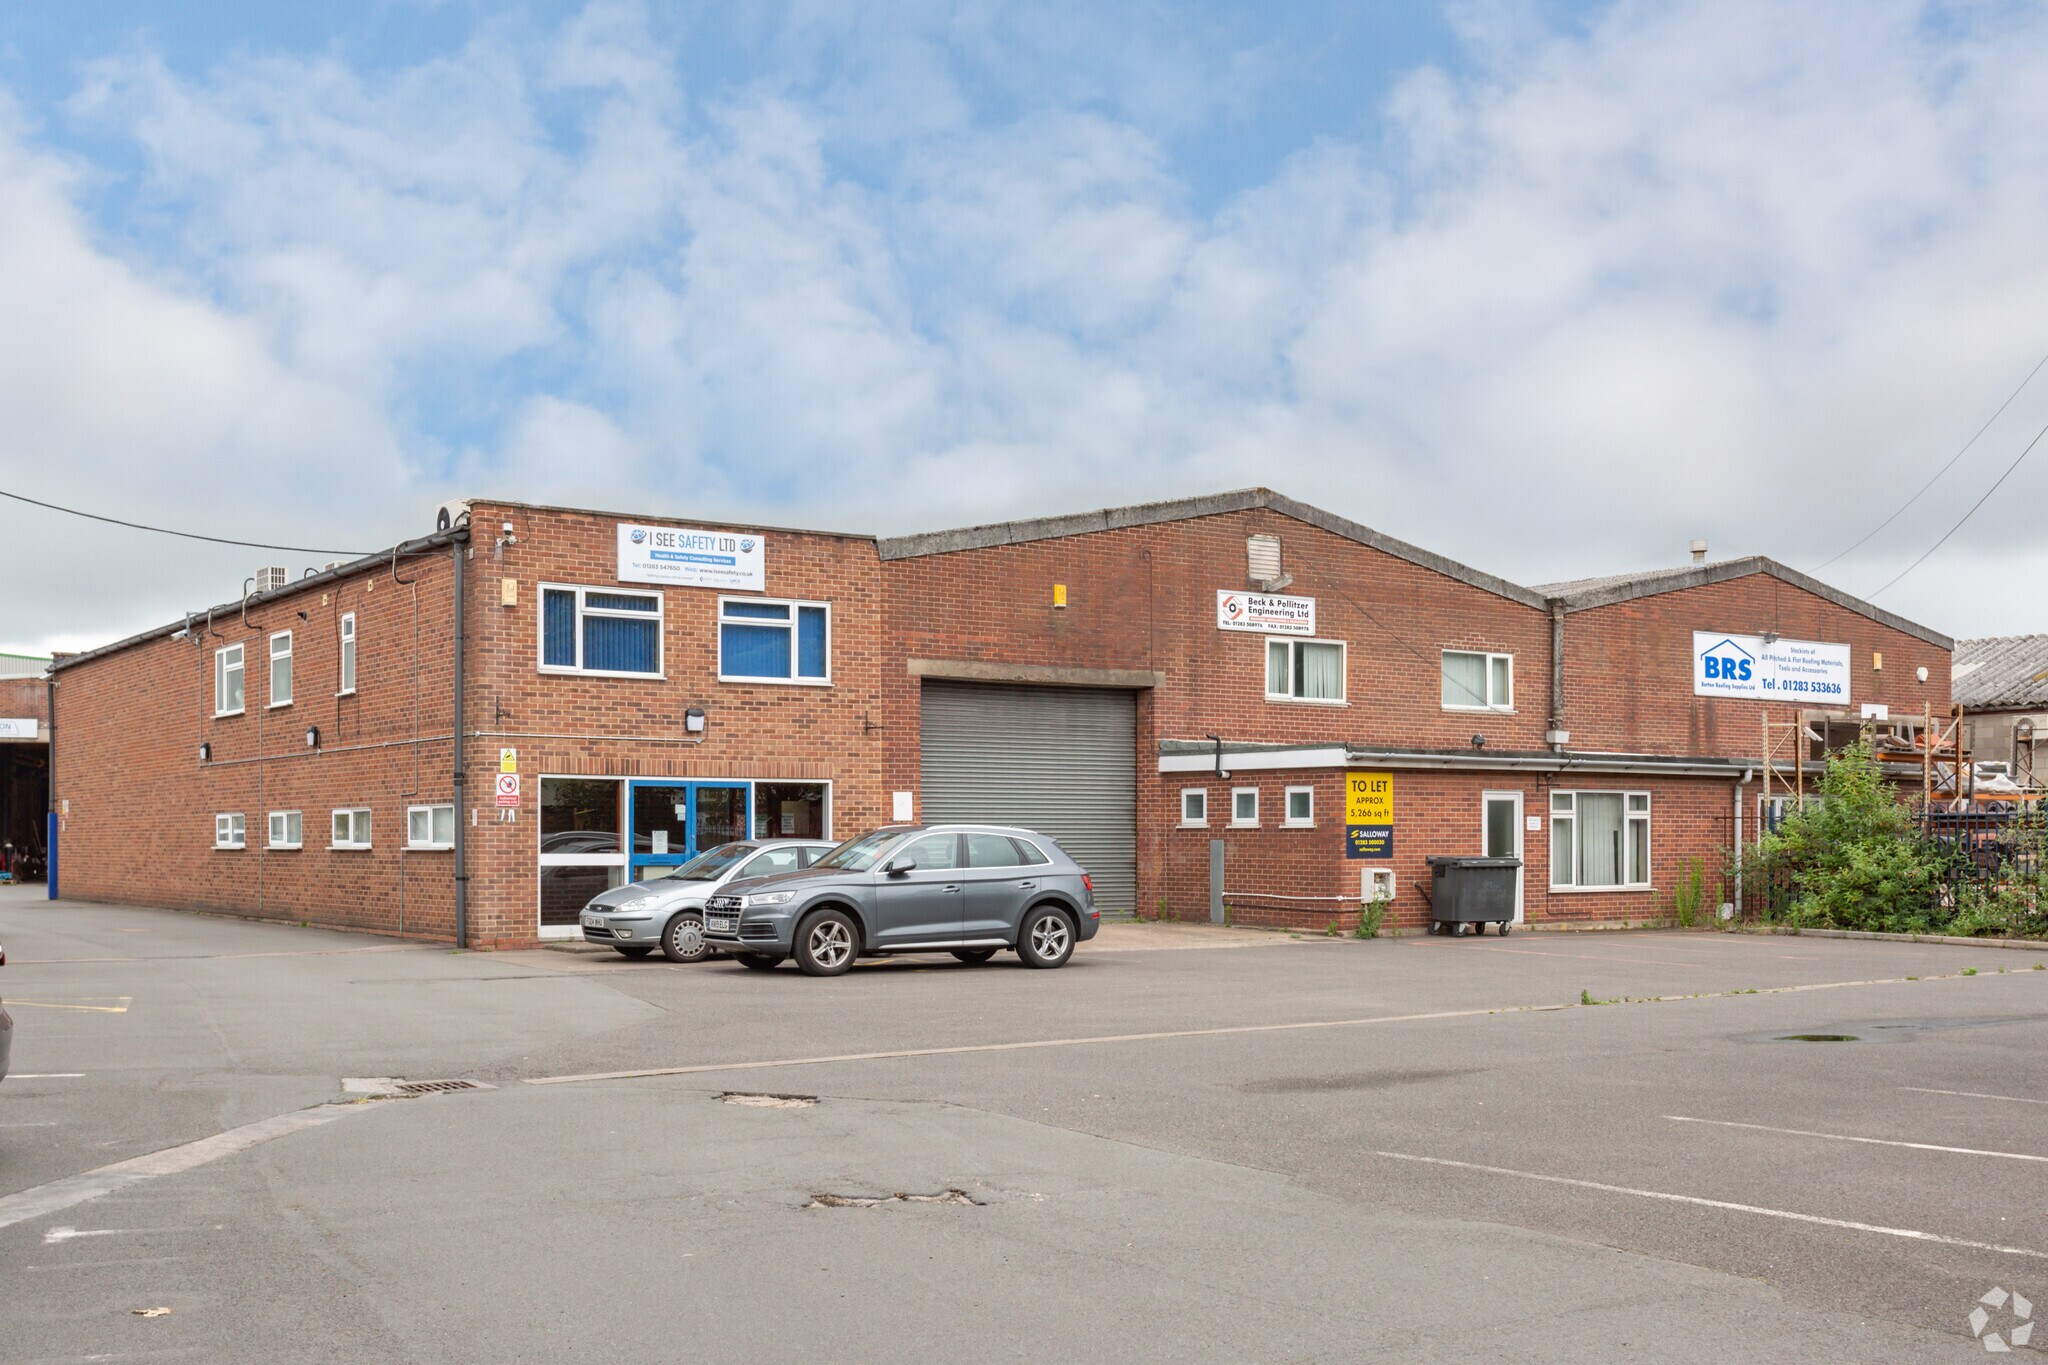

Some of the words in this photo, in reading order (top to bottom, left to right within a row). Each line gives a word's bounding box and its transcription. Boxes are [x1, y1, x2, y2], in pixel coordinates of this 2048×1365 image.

[649, 532, 653, 545] I
[656, 532, 675, 547] SEE
[678, 534, 716, 550] SAFETY
[719, 538, 736, 552] LTD
[689, 555, 713, 564] Consulting
[699, 568, 753, 577] www.iseesafety.co.uk
[1248, 597, 1266, 606] Beck
[1277, 599, 1309, 609] Pollitzer
[1248, 606, 1295, 618] Engineering
[1297, 610, 1309, 618] Ltd
[1790, 647, 1810, 655] Stockists
[1769, 655, 1787, 663] Pitched
[1792, 656, 1801, 664] Flat
[1802, 657, 1820, 666] Roofing
[1820, 658, 1844, 667] Materials,
[1704, 655, 1752, 682] BRS
[1801, 666, 1828, 675] Accessories
[1701, 681, 1715, 689] Burton
[1715, 682, 1731, 690] Roofing
[1731, 683, 1748, 691] Supplies
[1782, 680, 1809, 692] 01283
[1811, 681, 1842, 694] 533636
[1352, 780, 1367, 792] TO
[1371, 781, 1387, 792] LET
[1350, 809, 1372, 818] 5,266
[1374, 811, 1382, 819] sq
[1384, 809, 1389, 817] ft
[1359, 830, 1389, 838] SALLOWAY
